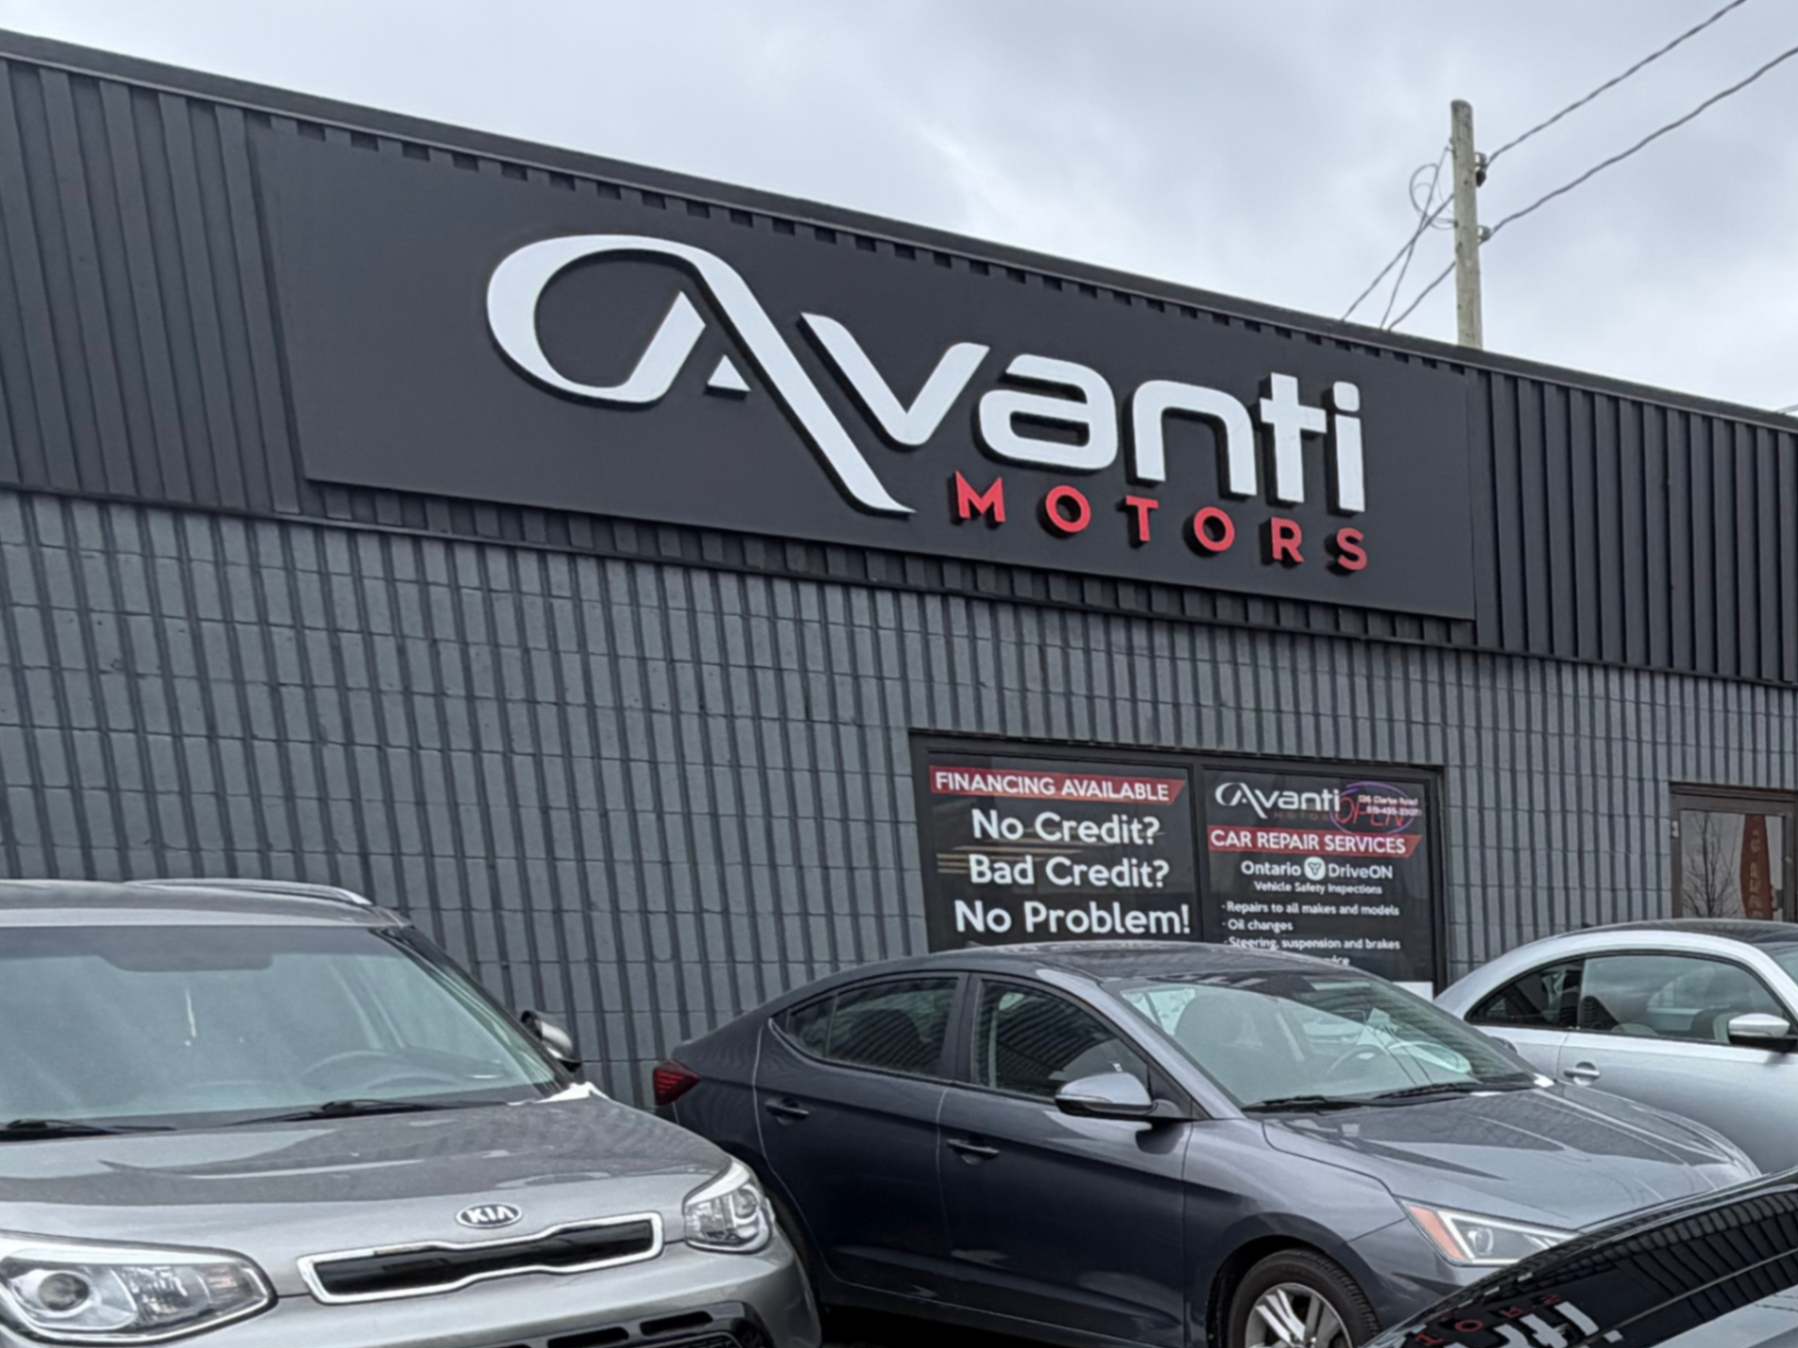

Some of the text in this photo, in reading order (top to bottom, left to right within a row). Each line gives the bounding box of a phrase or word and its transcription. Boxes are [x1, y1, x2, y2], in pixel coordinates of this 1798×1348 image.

[486, 233, 1367, 515] Avanti
[952, 470, 1369, 573] MOTORS
[935, 771, 1169, 801] FINANCING AVAILABLE
[1214, 782, 1340, 819] Avanti
[972, 808, 1160, 844] No Credit?
[1211, 830, 1406, 854] CAR REPAIR SERVICES
[968, 854, 1169, 887] Bad Credit?
[1241, 860, 1393, 879] Ontario DriveON
[1254, 881, 1382, 895] Vehicle Safety Inspections
[954, 899, 1191, 933] No Problem!
[1226, 901, 1399, 915] Repairs to all makes and models
[1227, 919, 1293, 933] Oil changes
[1281, 938, 1341, 950] suspension
[1343, 939, 1363, 949] and
[1365, 939, 1401, 949] brakes
[467, 1206, 515, 1223] KIA
